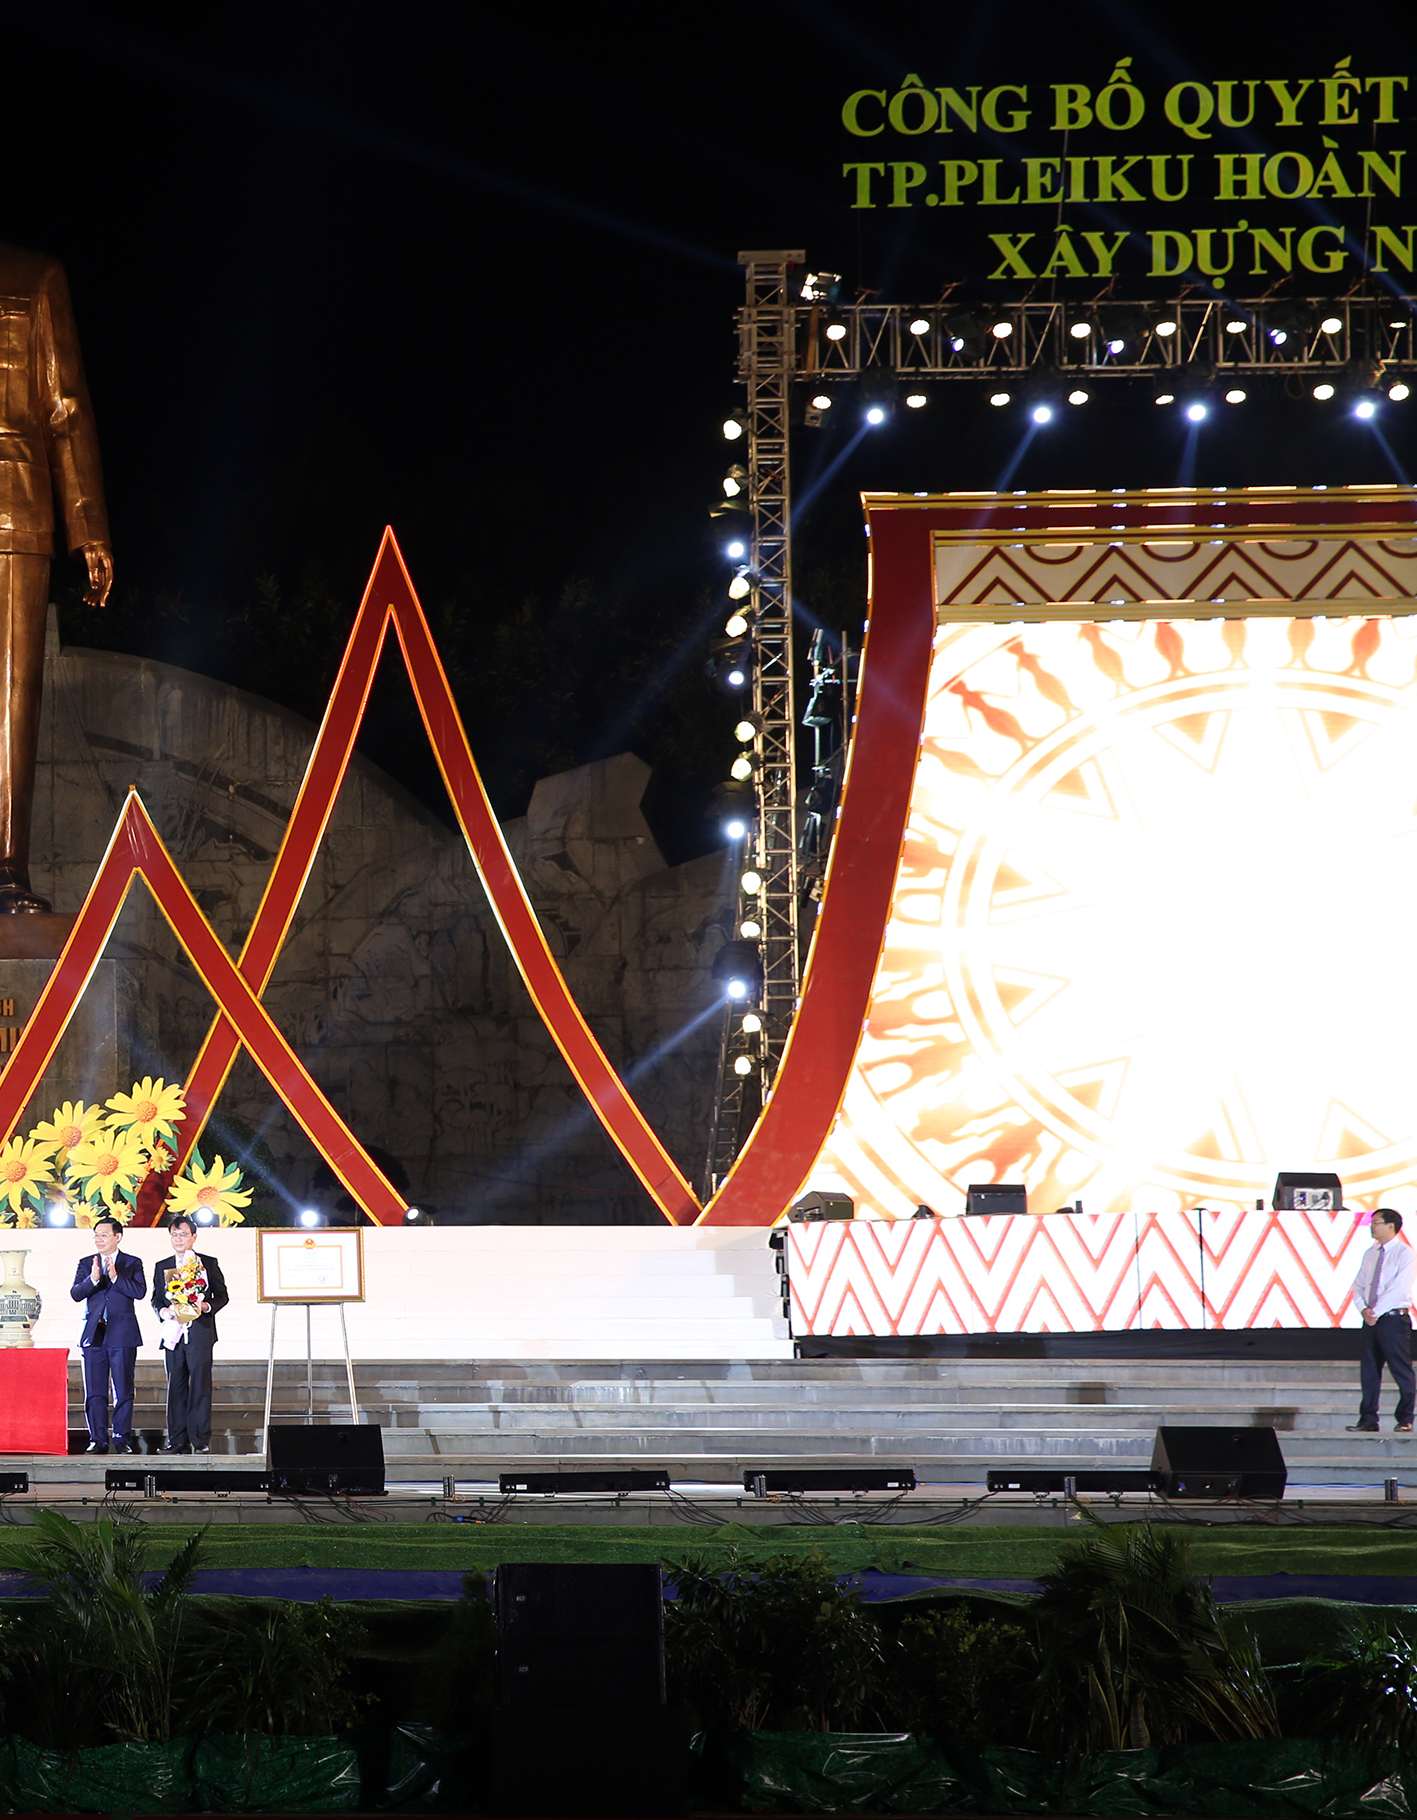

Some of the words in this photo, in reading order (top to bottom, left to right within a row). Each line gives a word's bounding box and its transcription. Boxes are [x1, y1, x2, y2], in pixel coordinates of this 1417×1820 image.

[841, 73, 1031, 137] CÔNG
[1049, 56, 1146, 131] BỐ
[1163, 55, 1409, 140] QUYẾT
[842, 154, 1195, 209] TP.PLEIKU
[1213, 135, 1407, 201] HOÀN
[987, 224, 1131, 280] XÂY
[1145, 219, 1350, 290] DỰNG
